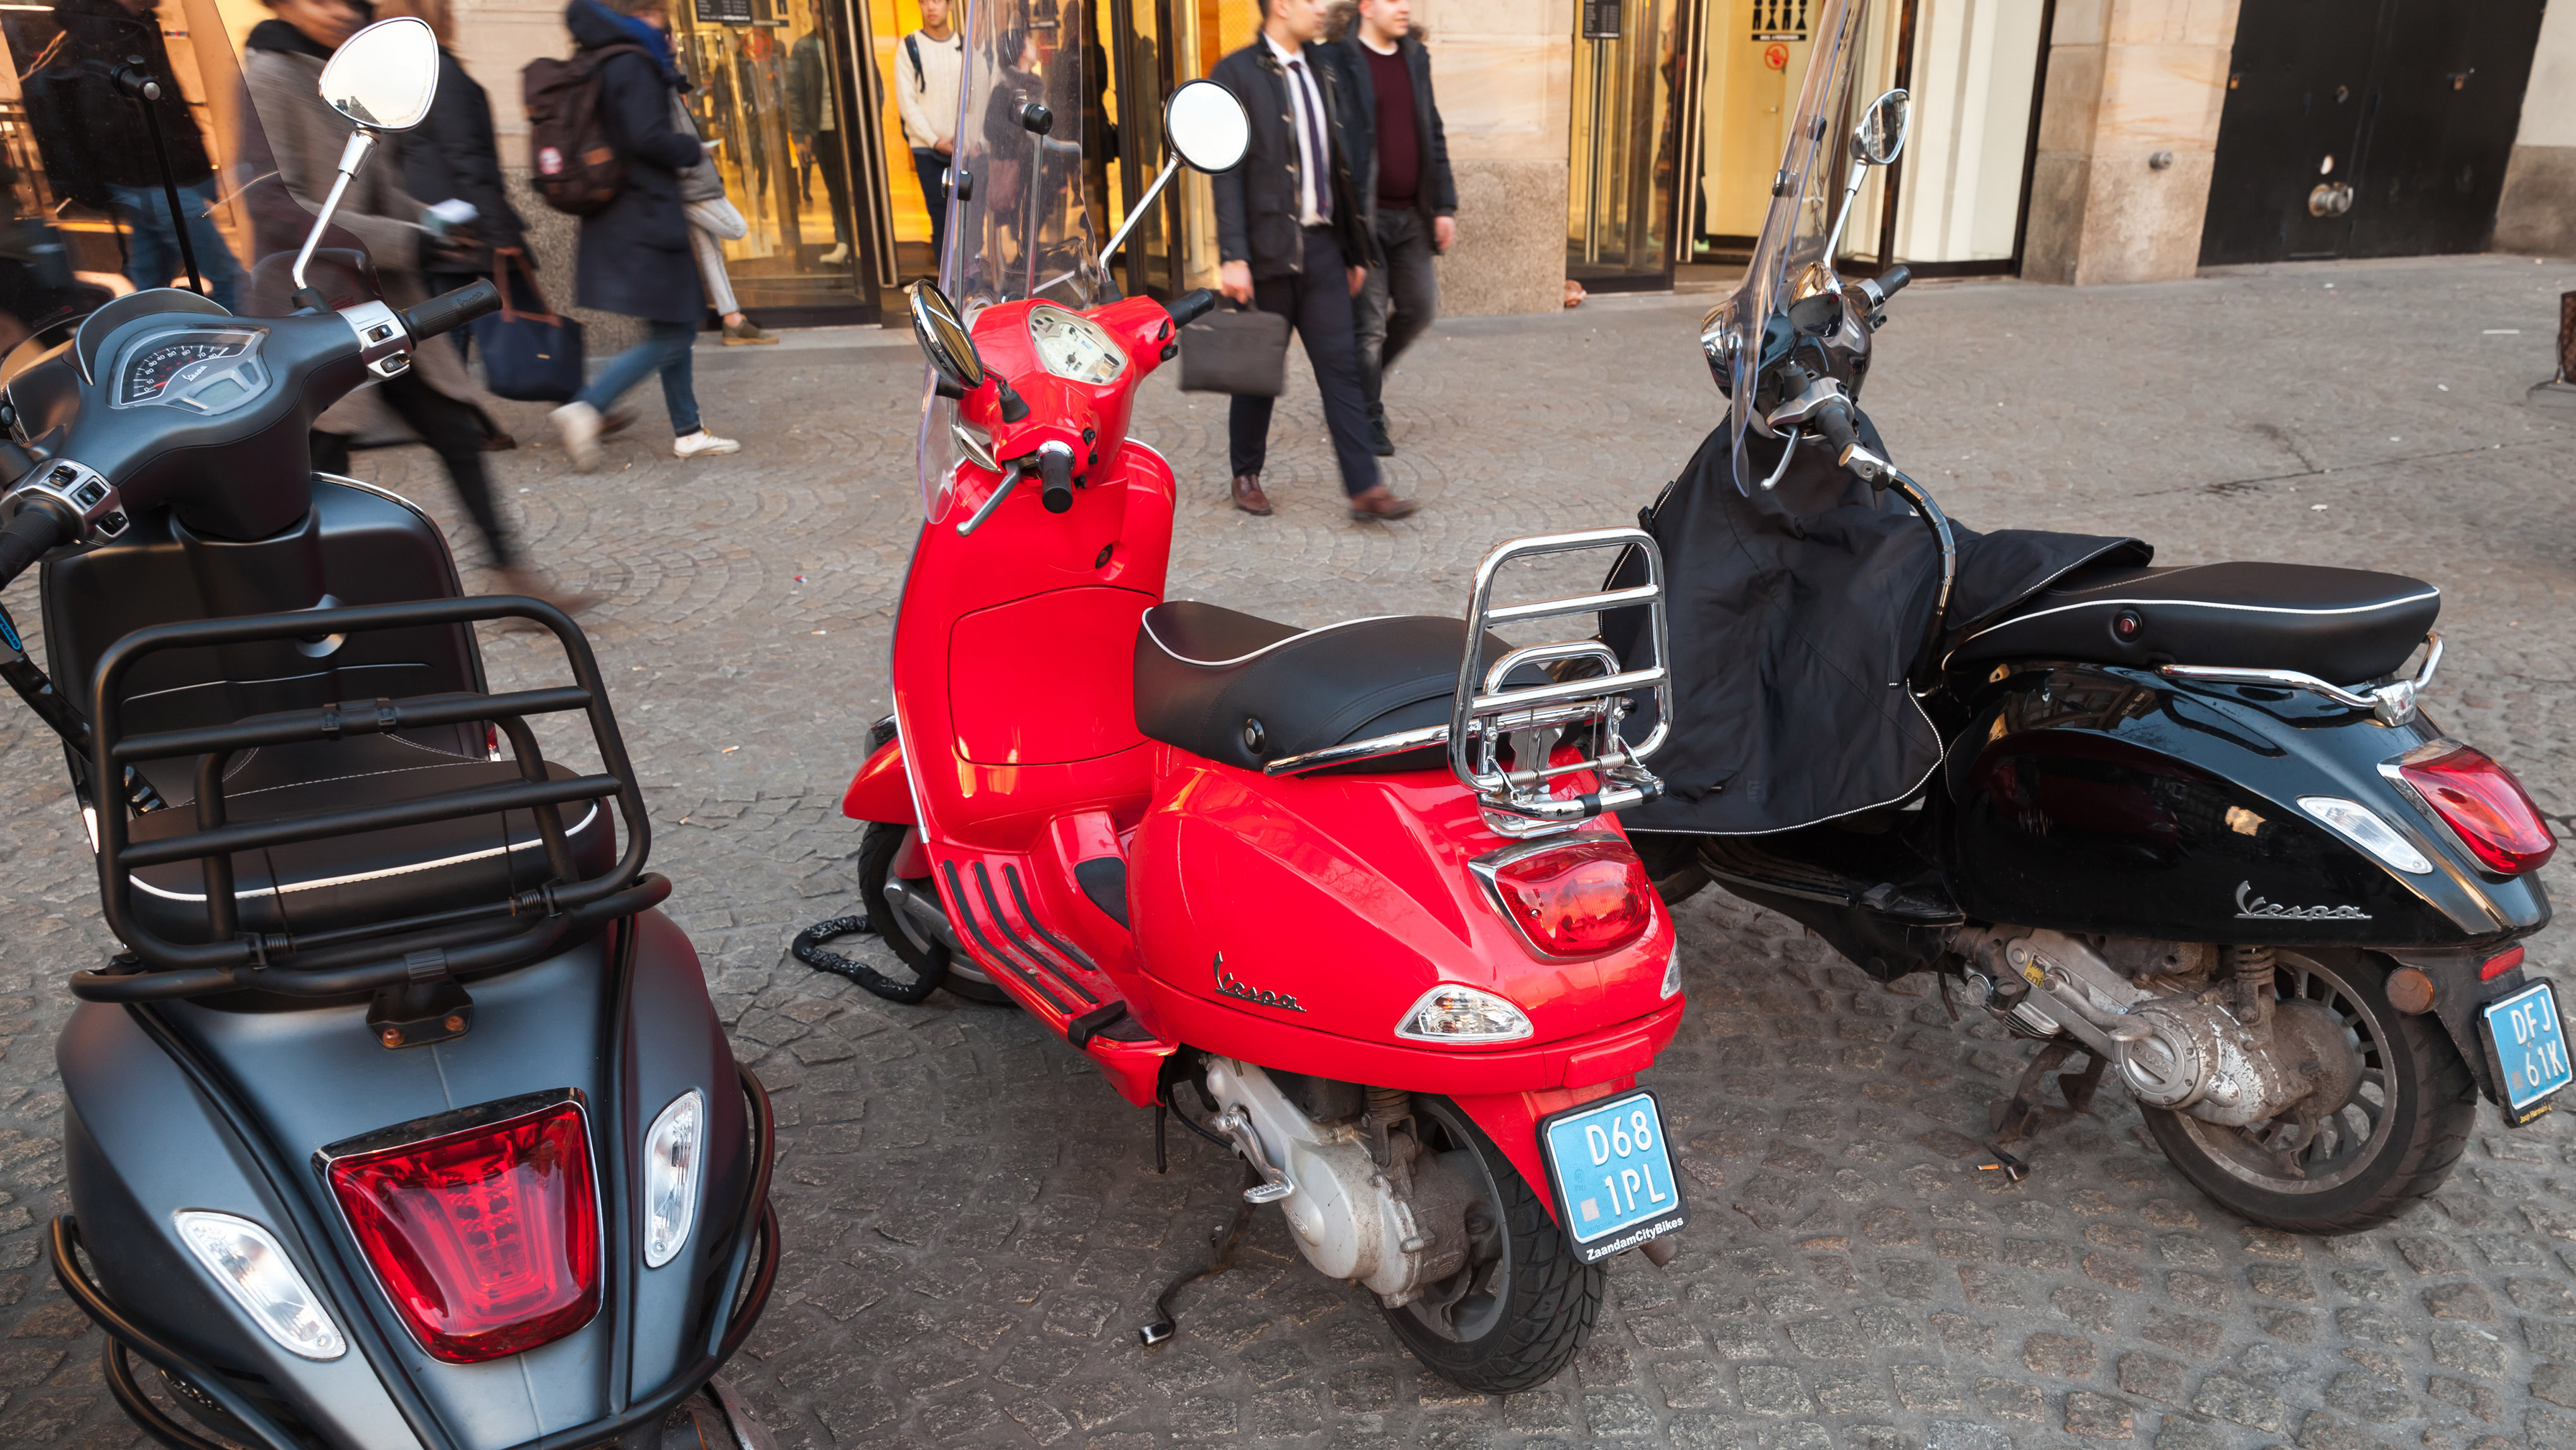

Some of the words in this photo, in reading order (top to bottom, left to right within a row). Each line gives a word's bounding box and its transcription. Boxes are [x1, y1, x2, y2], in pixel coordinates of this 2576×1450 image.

[181, 365, 208, 382] Vespa
[2233, 880, 2372, 921] Vespa
[1213, 951, 1307, 1013] Vespa
[2510, 996, 2551, 1045] DFJ
[2525, 1040, 2565, 1087] 61K
[1585, 1110, 1652, 1166] D68
[1605, 1163, 1666, 1216] 1PL
[1586, 1217, 1684, 1261] ZaandamCityBikes
